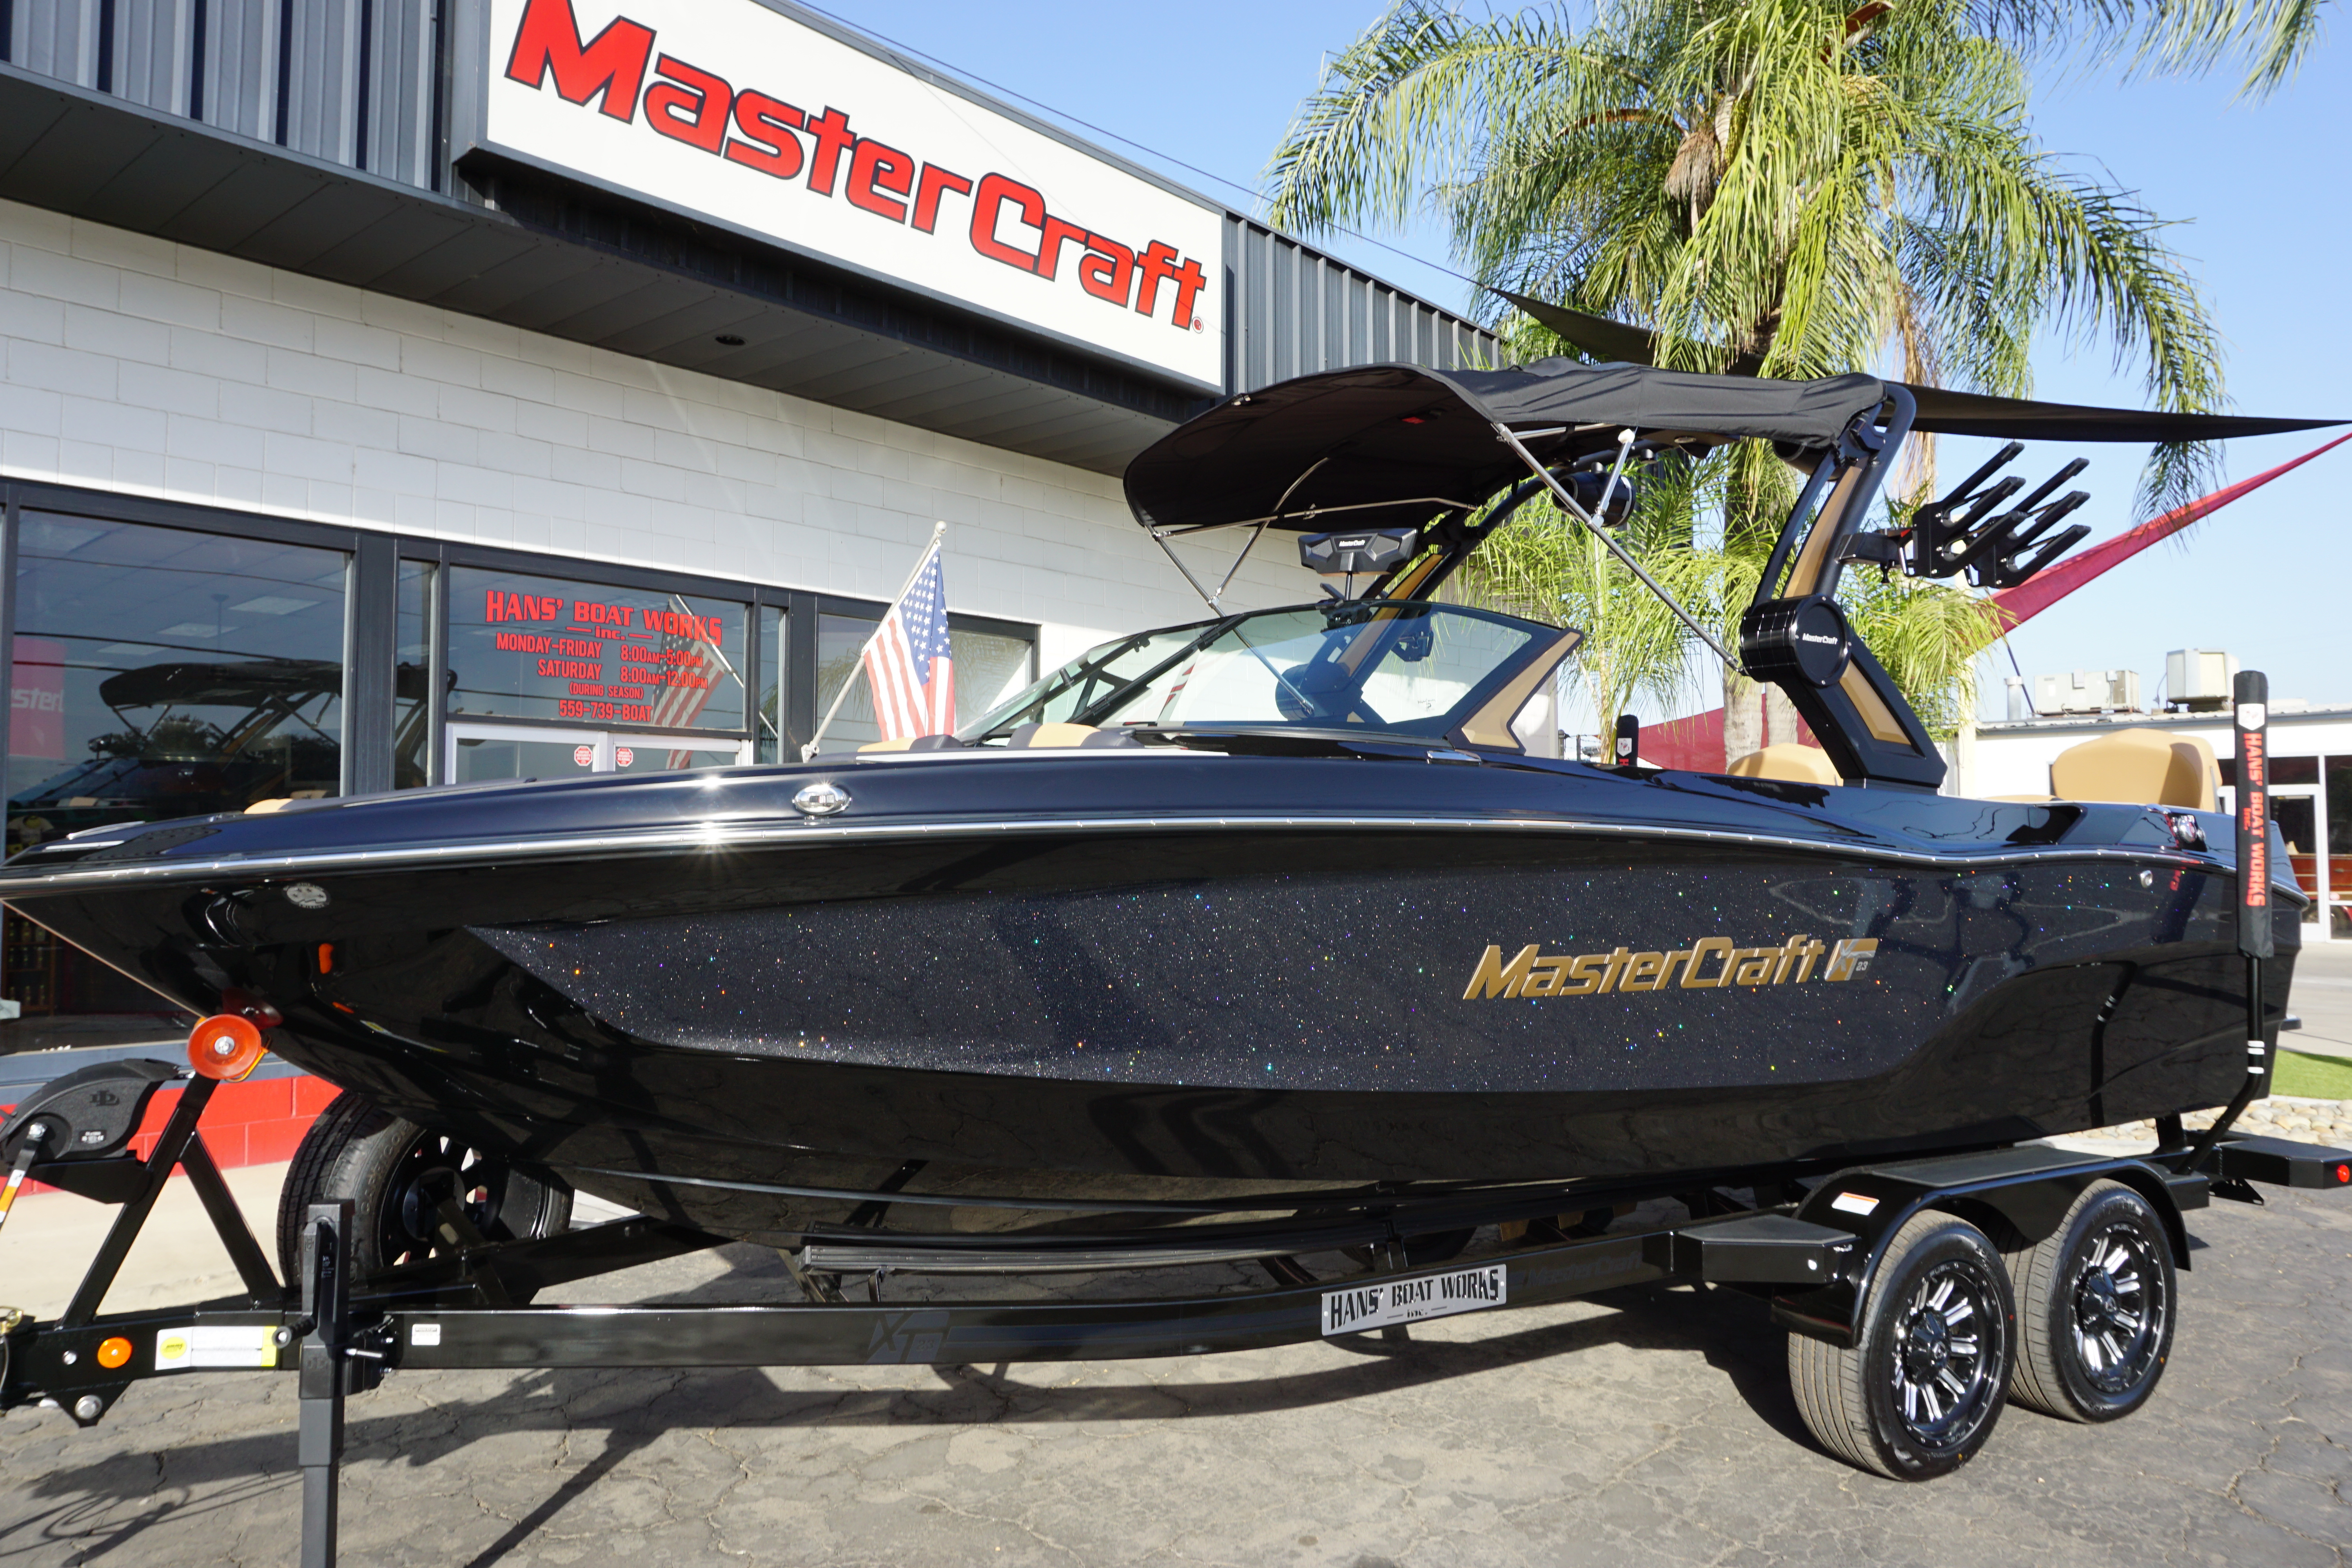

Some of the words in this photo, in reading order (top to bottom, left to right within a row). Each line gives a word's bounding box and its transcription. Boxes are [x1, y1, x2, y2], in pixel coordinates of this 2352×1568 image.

[504, 0, 1207, 331] MasterCraft
[486, 590, 563, 622] HANS'
[573, 601, 634, 628] BOAT
[642, 609, 722, 646] WORKS
[595, 625, 626, 641] inc.
[496, 632, 603, 659] MONDAY-FRIDAY
[620, 644, 703, 668] 8:00AM-5:00PM
[1802, 633, 1838, 645] MasterCraft
[537, 659, 602, 680] SATURDAY
[620, 666, 708, 690] 8:00AM-12:00PM
[569, 681, 604, 697] (DURING
[608, 685, 644, 700] SEASON)
[559, 699, 652, 722] 559-739-BOAT
[2243, 732, 2263, 787] HANS'
[2249, 791, 2264, 838] BOAT
[2246, 842, 2266, 907] WORKS
[1463, 934, 1826, 1000] MasterCraft
[1856, 961, 1868, 971] 23
[1392, 1279, 1434, 1308] BOAT
[1441, 1269, 1499, 1301] WORKS
